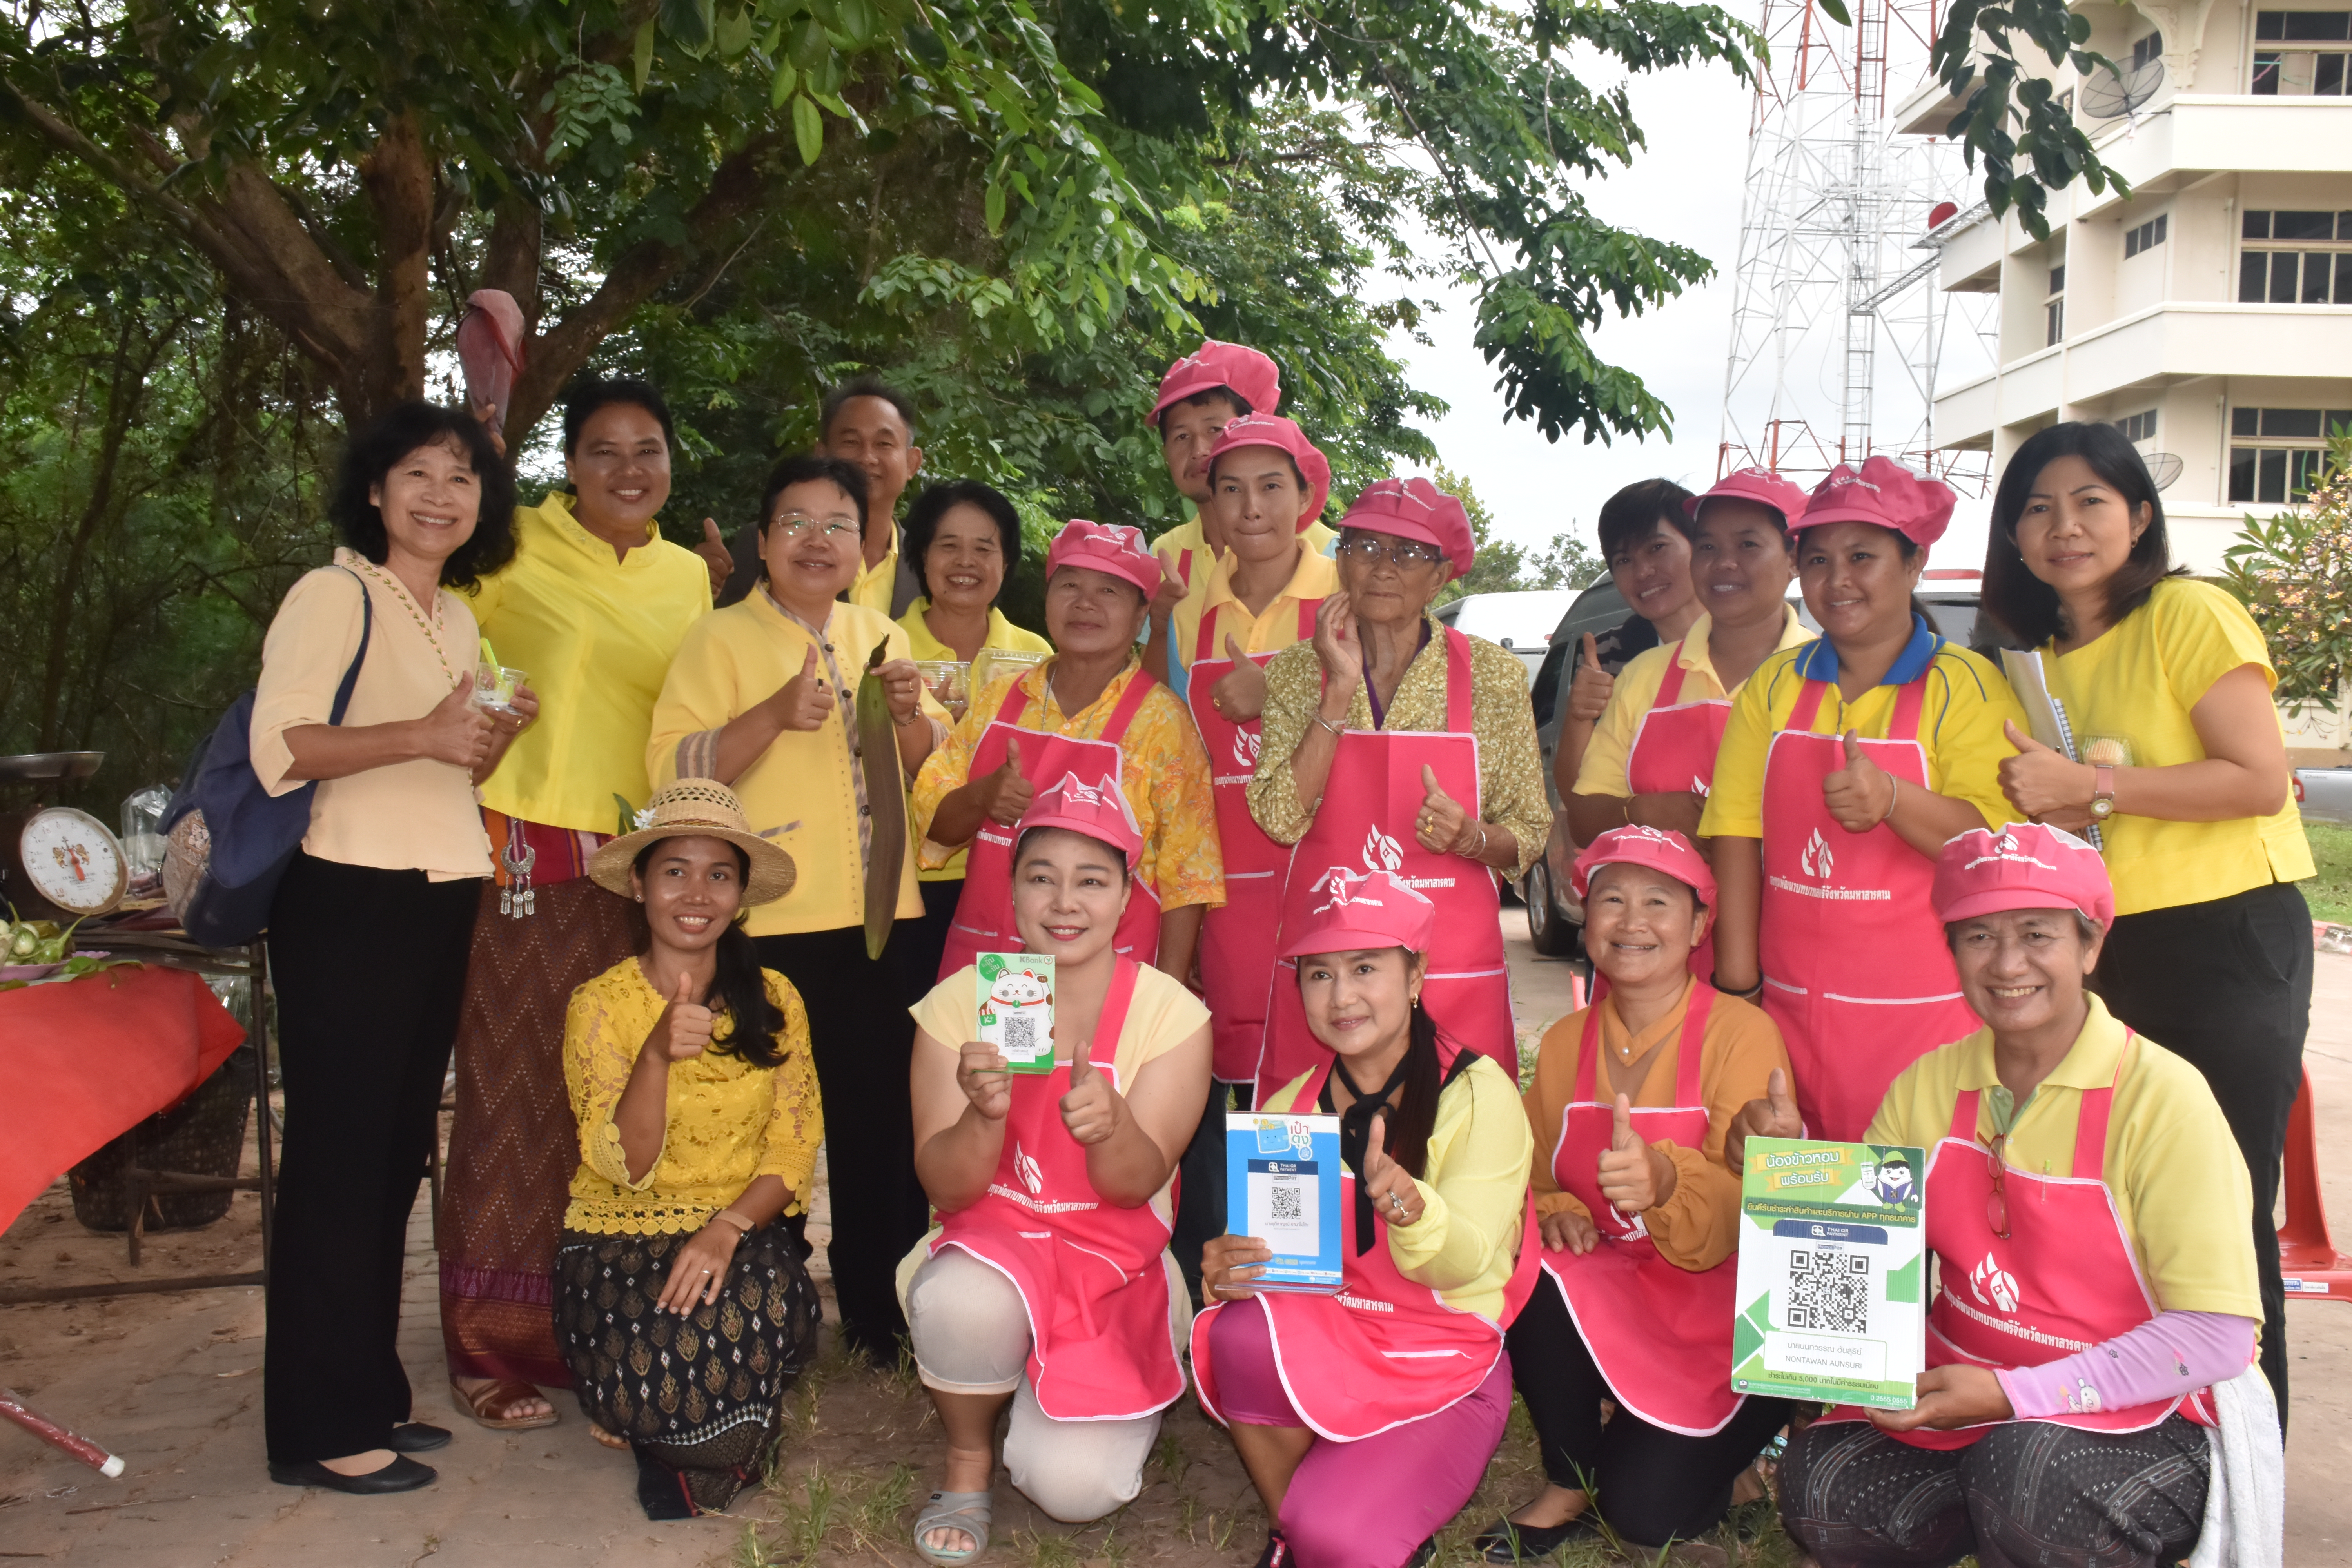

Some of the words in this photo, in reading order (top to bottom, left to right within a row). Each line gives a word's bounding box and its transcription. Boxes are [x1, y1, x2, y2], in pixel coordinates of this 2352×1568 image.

[1291, 1121, 1309, 1134] เป๋า
[1292, 1135, 1309, 1148] ตุง
[1766, 1151, 1839, 1168] น้องข้าวหอม
[1781, 1171, 1829, 1185] พร้อมรับ
[1747, 1202, 1859, 1218] ยินดีรับชำระค่าสินค้าและบริการผ่าน
[1879, 1214, 1916, 1223] ทุกธนาคาร
[1785, 1356, 1827, 1365] NONTAWAN
[1829, 1360, 1862, 1369] AUNSURI
[1768, 1372, 1797, 1381] ชำระไม่เกิน
